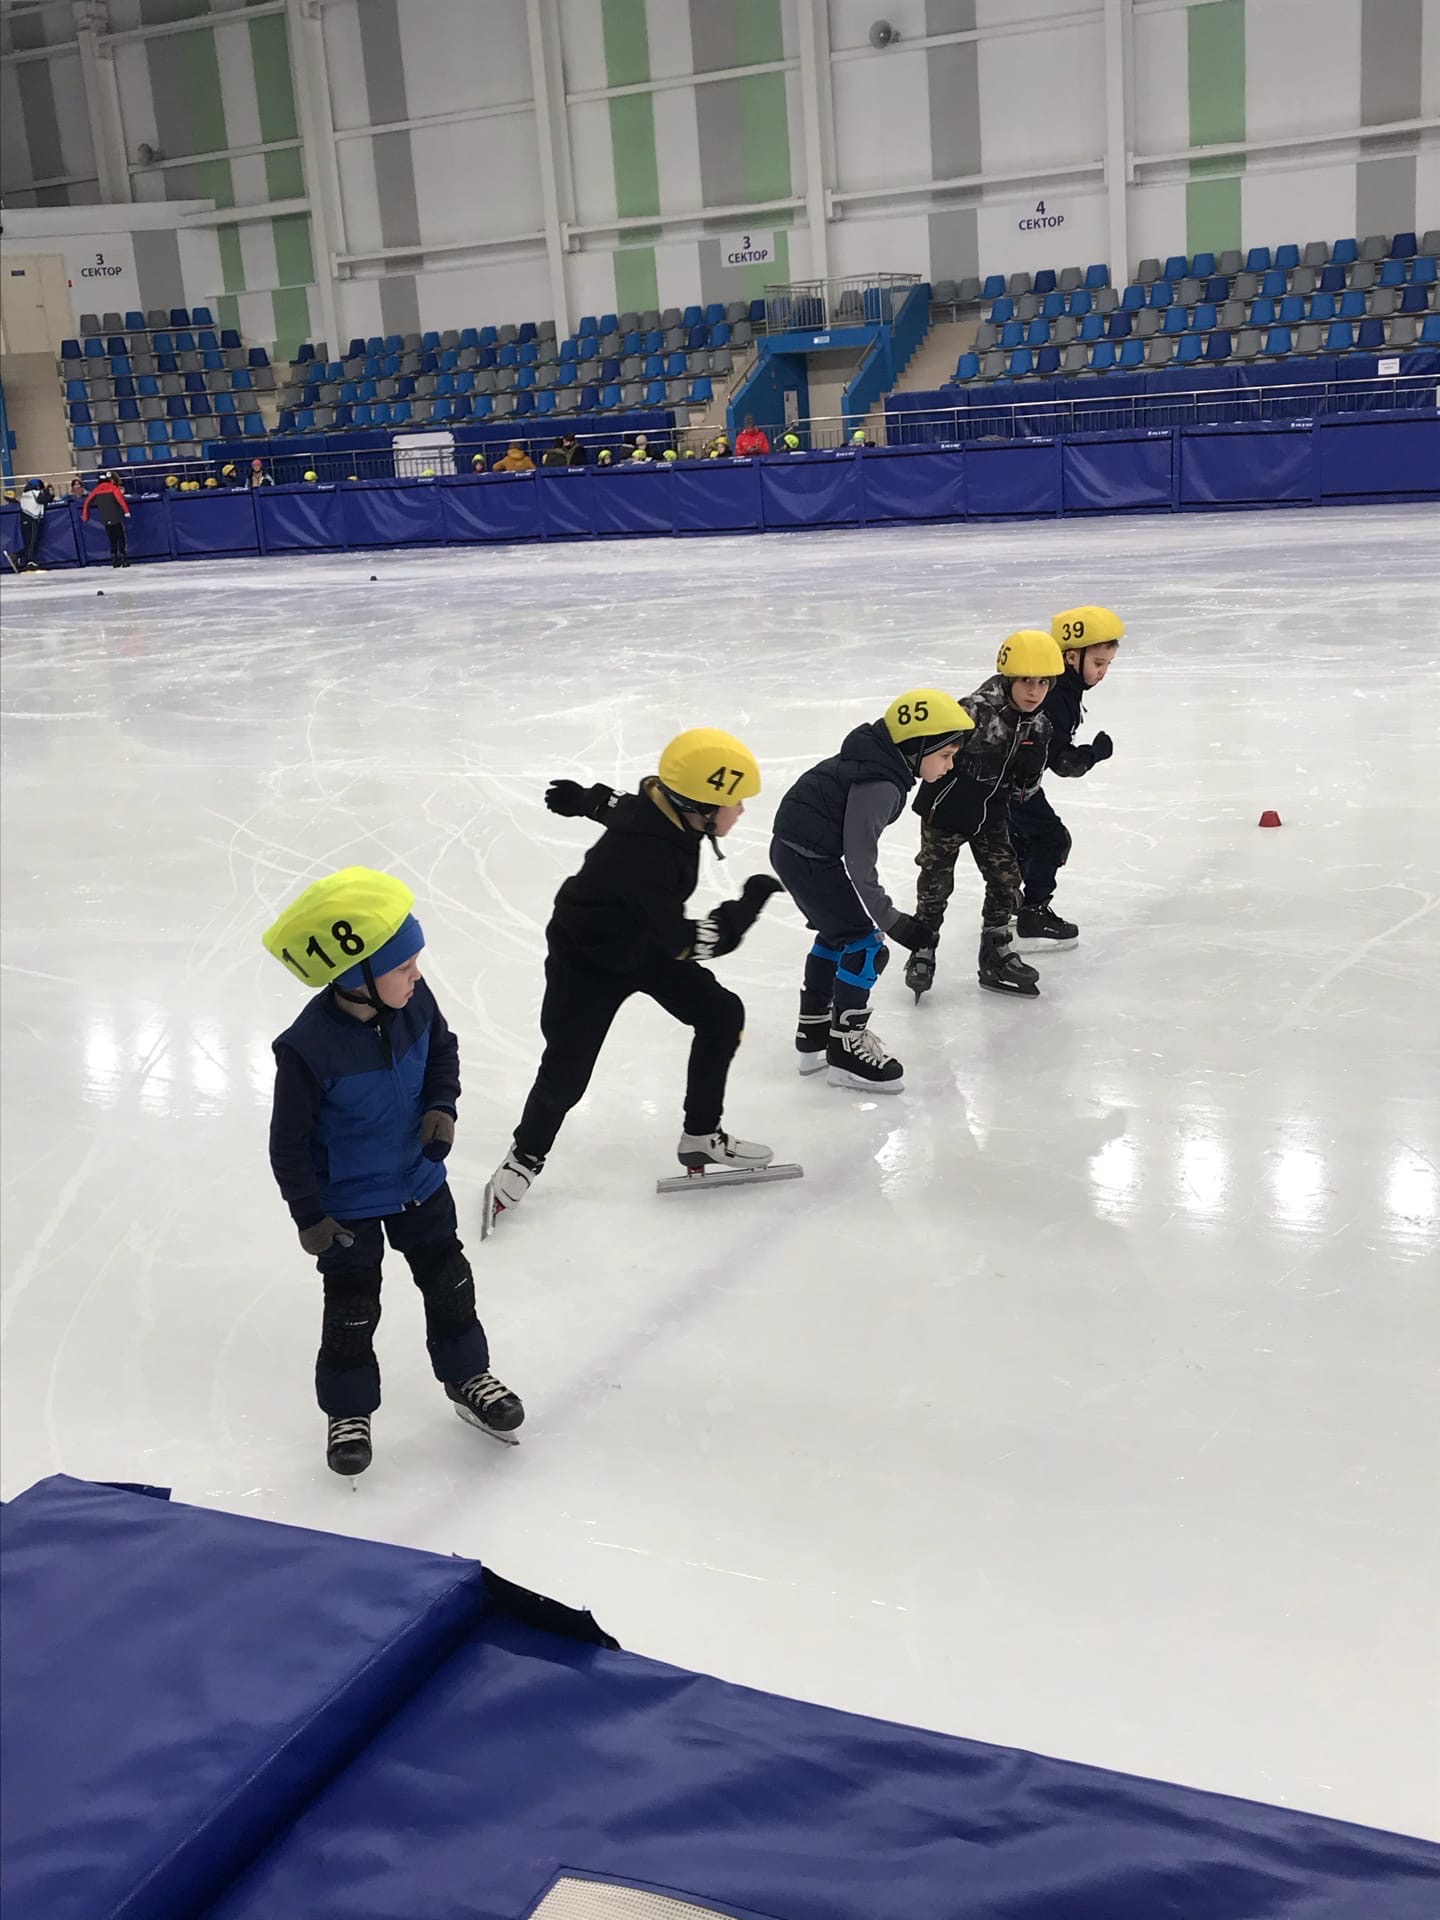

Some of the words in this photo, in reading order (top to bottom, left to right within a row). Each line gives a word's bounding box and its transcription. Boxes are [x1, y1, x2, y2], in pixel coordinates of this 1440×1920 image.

[1036, 200, 1046, 214] 4
[1018, 215, 1064, 230] СЕКТОР
[743, 236, 751, 249] 3
[95, 254, 104, 265] 3
[728, 250, 768, 264] СЕКТОР
[81, 267, 122, 277] СЕКТОР
[1062, 621, 1084, 641] 39
[897, 701, 928, 725] 85
[707, 766, 744, 795] 47
[282, 920, 365, 978] 118
